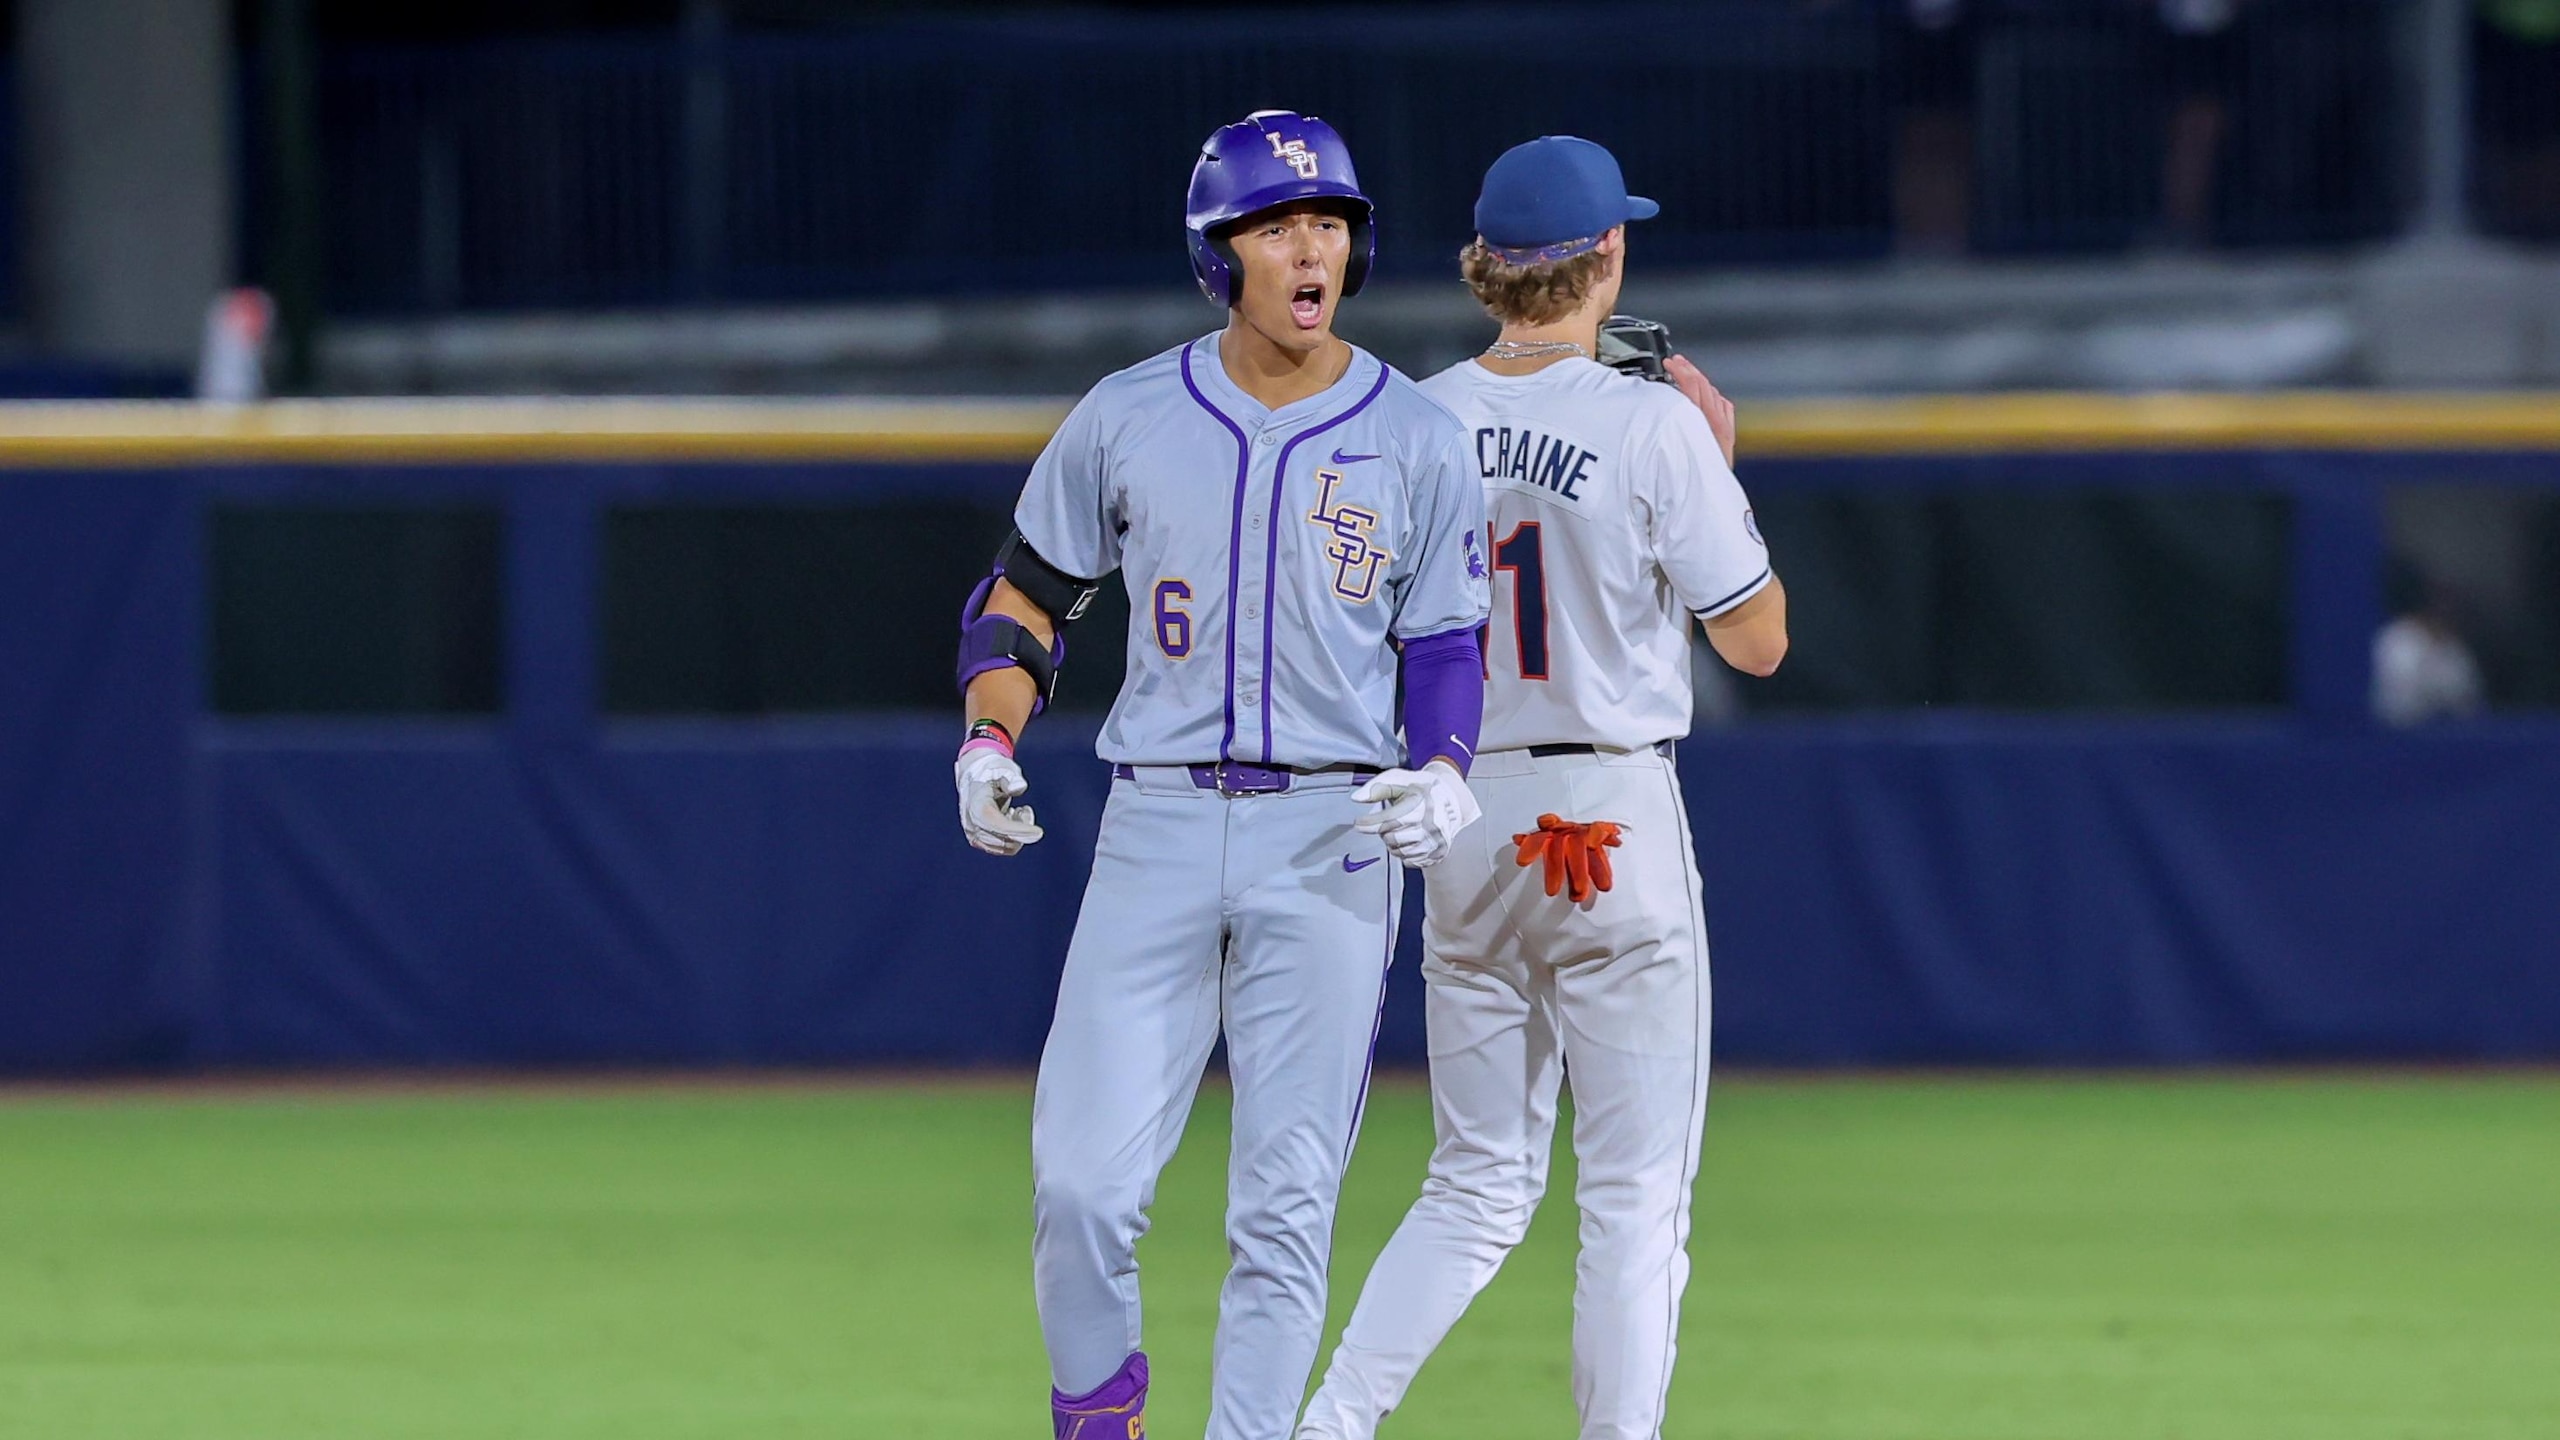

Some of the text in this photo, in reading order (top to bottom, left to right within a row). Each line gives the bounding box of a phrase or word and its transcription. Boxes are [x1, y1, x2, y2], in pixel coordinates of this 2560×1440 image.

[1265, 131, 1318, 179] LSU
[1476, 427, 1598, 502] CRAINE
[1306, 468, 1391, 605] LSU
[1151, 577, 1193, 661] 6
[1478, 520, 1549, 681] 1
